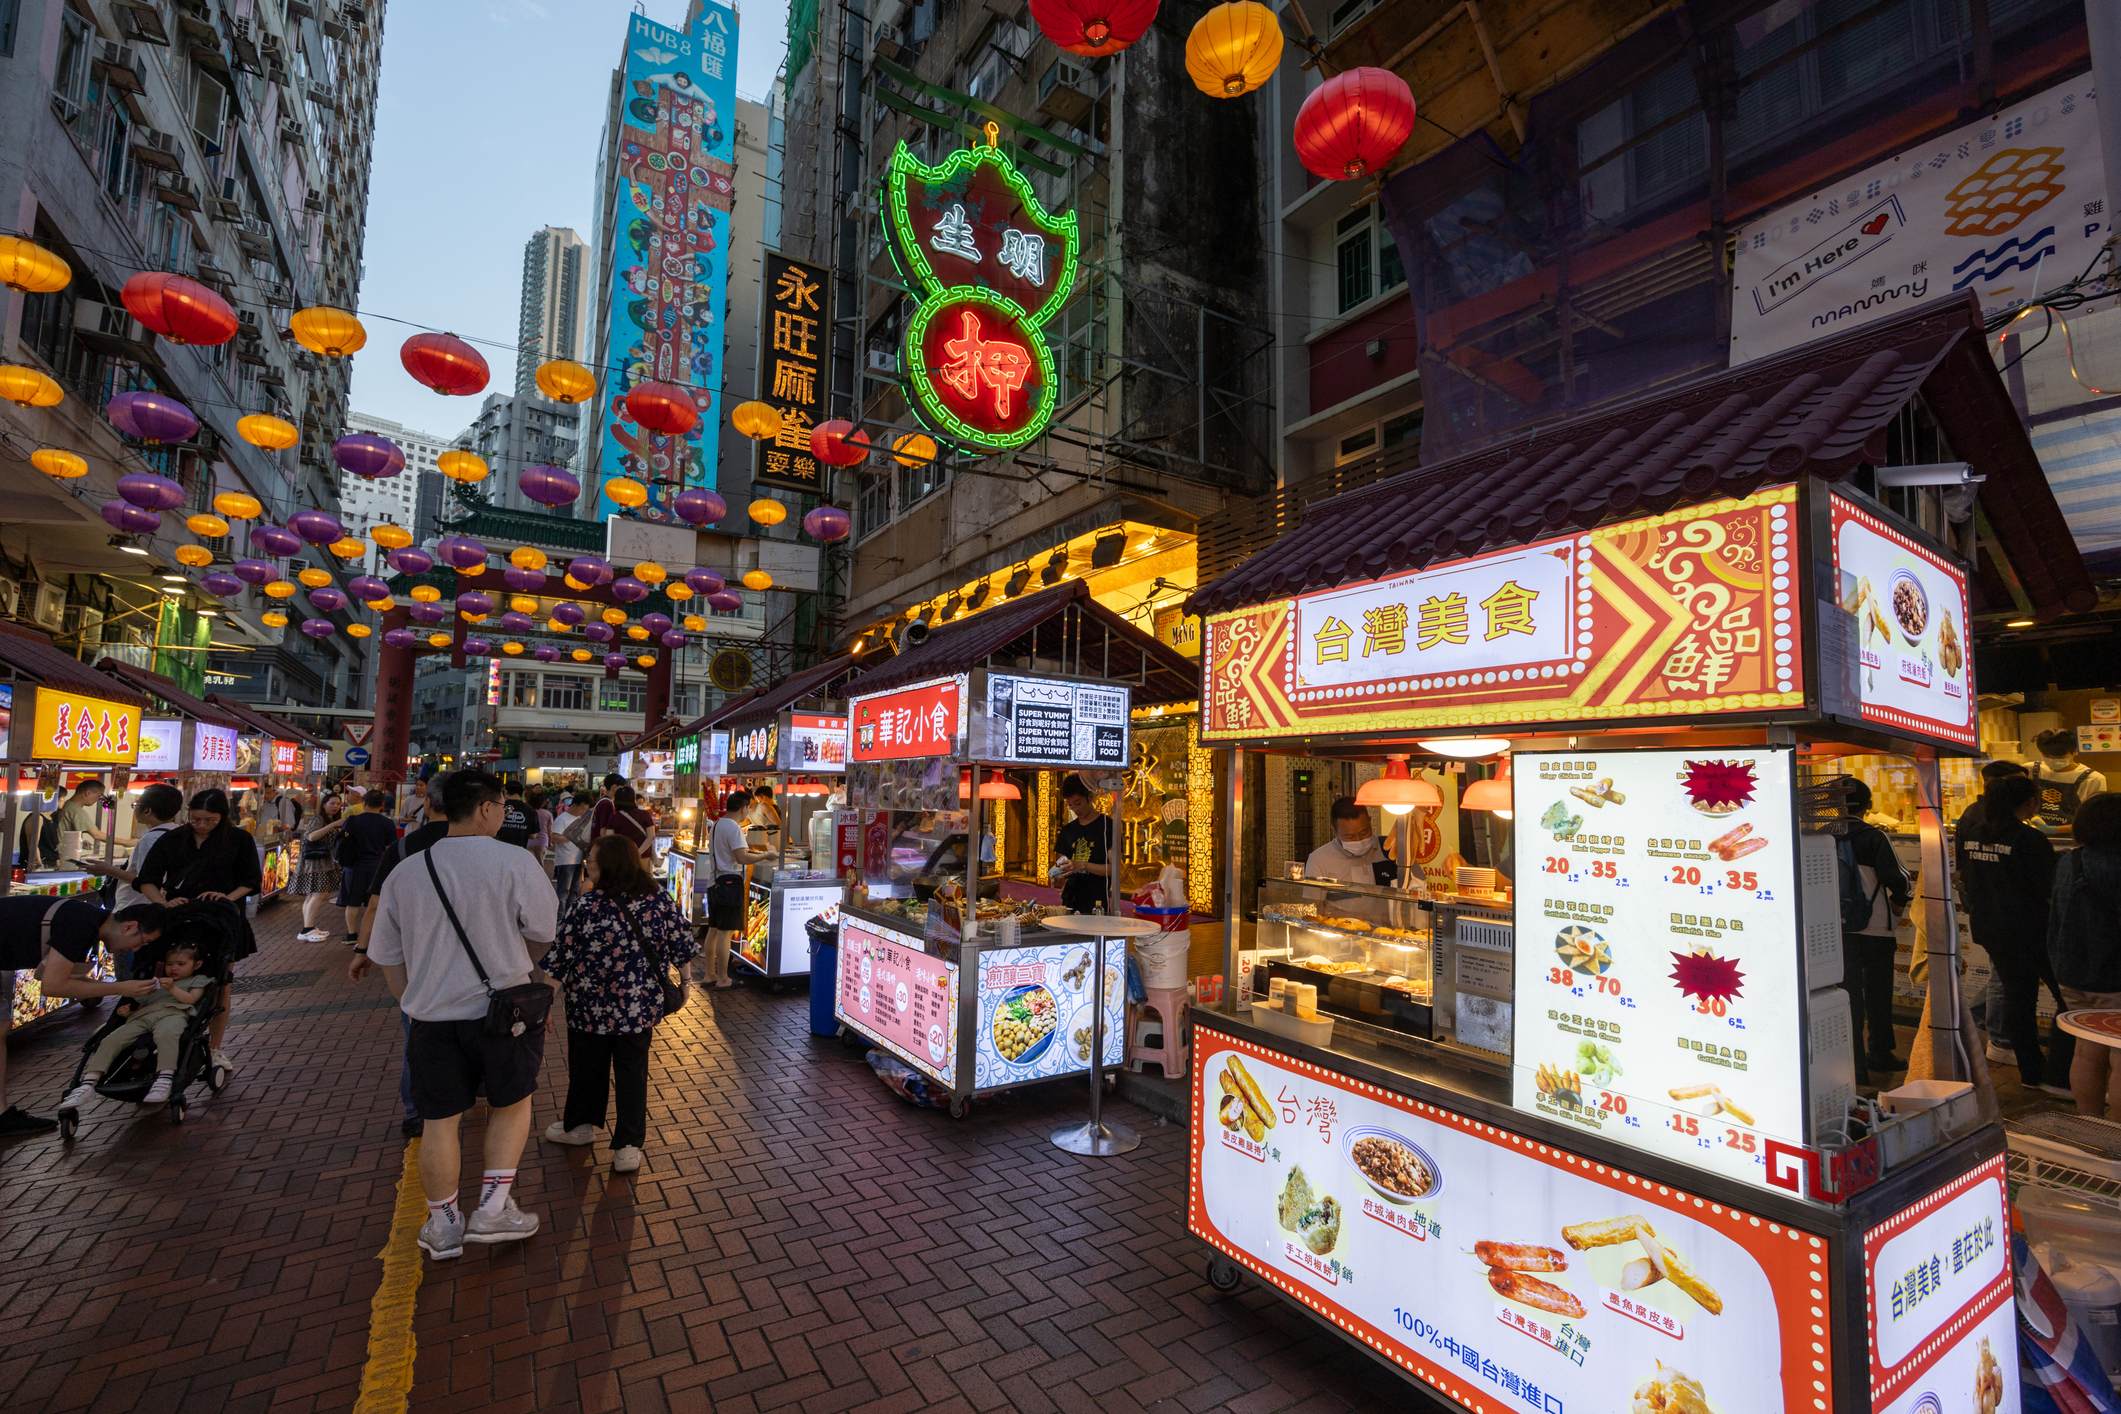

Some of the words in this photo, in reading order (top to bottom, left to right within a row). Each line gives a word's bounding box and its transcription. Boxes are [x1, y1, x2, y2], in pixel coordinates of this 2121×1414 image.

[702, 10, 728, 80] 八福匯
[1768, 271, 1801, 297] I'm
[1804, 237, 1859, 275] Here
[773, 265, 820, 452] 永旺麻雀
[939, 311, 1032, 420] 押
[1388, 577, 1415, 590] TAIWAN
[1312, 580, 1540, 665] 台灣美食
[53, 703, 130, 755] 美食大王
[879, 700, 950, 749] 華記小食
[1018, 709, 1042, 718] SUPER
[1044, 711, 1070, 720] YUMMY
[1018, 728, 1042, 736] SUPER
[1043, 729, 1070, 738] YUMMY
[1097, 739, 1121, 748] STREET
[1018, 745, 1042, 754] SUPER
[1043, 747, 1069, 756] YUMMY
[1099, 748, 1119, 757] FOOD
[1670, 925, 1704, 936] Cuttlefish
[1705, 929, 1722, 938] Dice
[987, 963, 1046, 990] 煎釀三寶
[1728, 1017, 1736, 1026] 6
[1277, 1085, 1340, 1145] 台灣
[1261, 1140, 1282, 1163] 人氣
[1363, 1198, 1420, 1236] 府城滷肉飯
[1414, 1209, 1442, 1240] 地道
[1285, 1242, 1333, 1278] 手工胡椒餅
[1500, 1307, 1553, 1344] 台灣香腸
[1553, 1336, 1586, 1368] 進口
